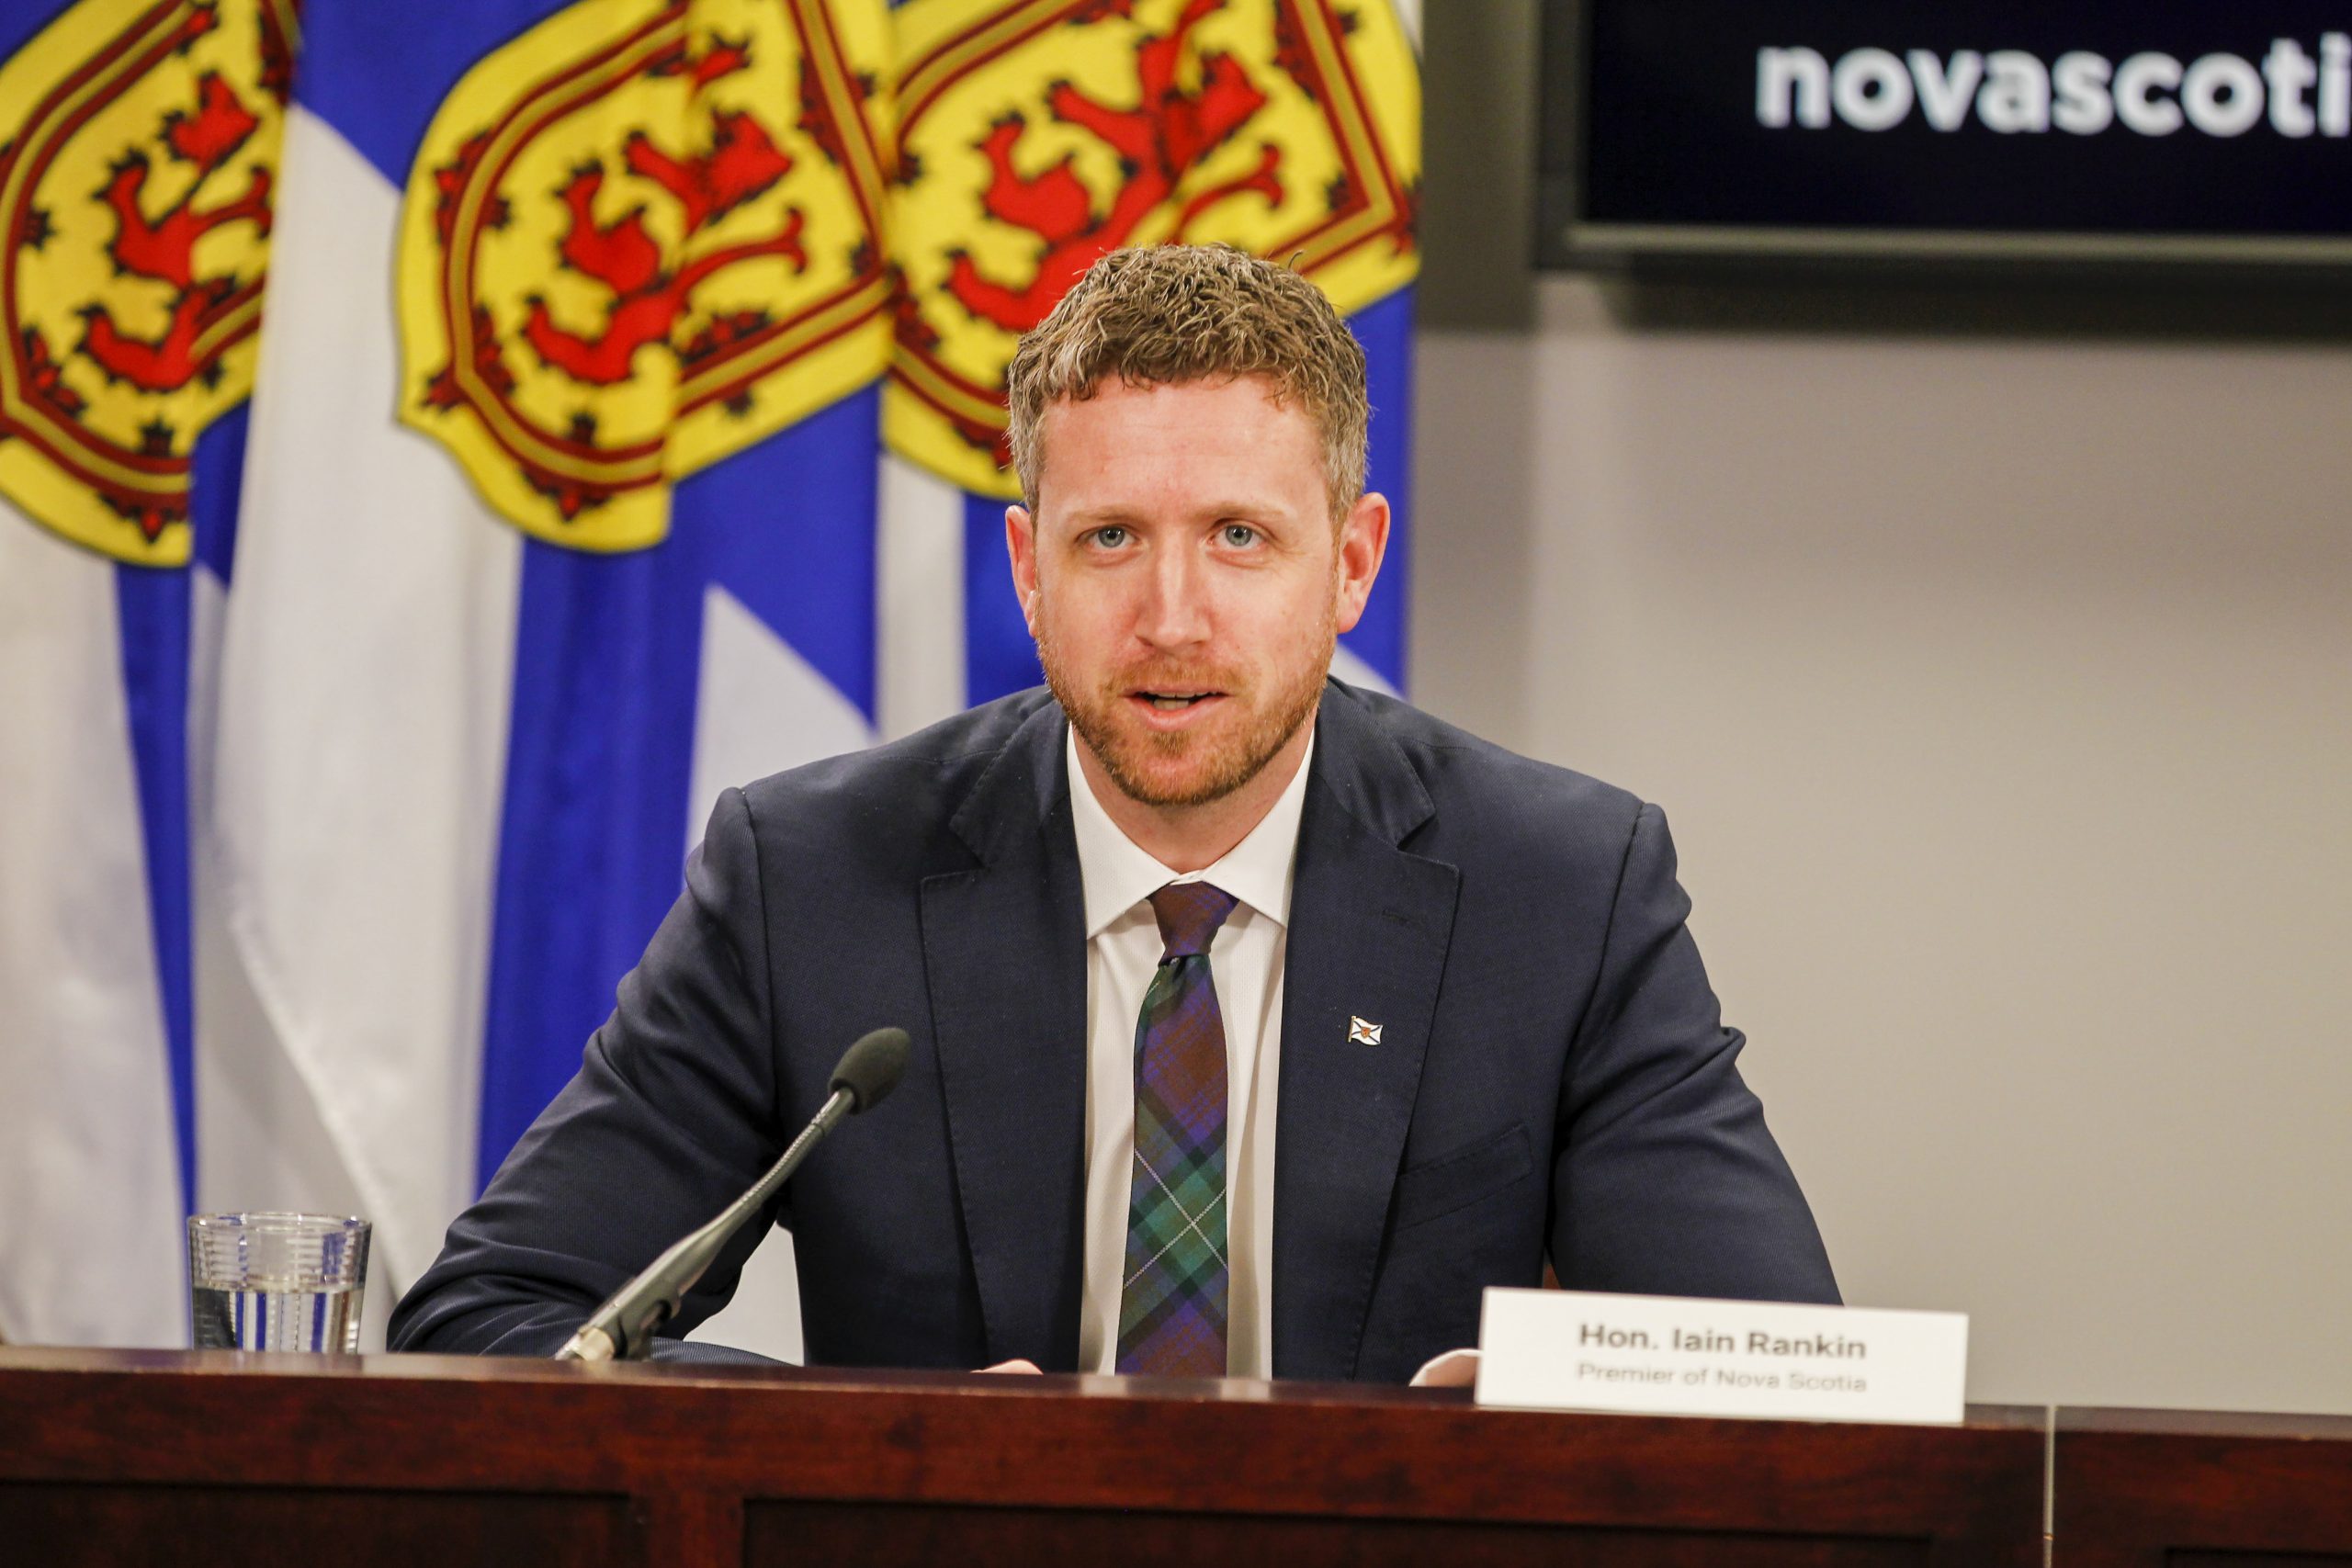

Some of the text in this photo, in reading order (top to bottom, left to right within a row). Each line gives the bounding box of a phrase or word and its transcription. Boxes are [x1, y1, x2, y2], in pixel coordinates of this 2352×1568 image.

[1578, 1323, 1867, 1360] Hon. Iain Rankin
[1577, 1361, 1868, 1393] Premier of Nova Scotia
